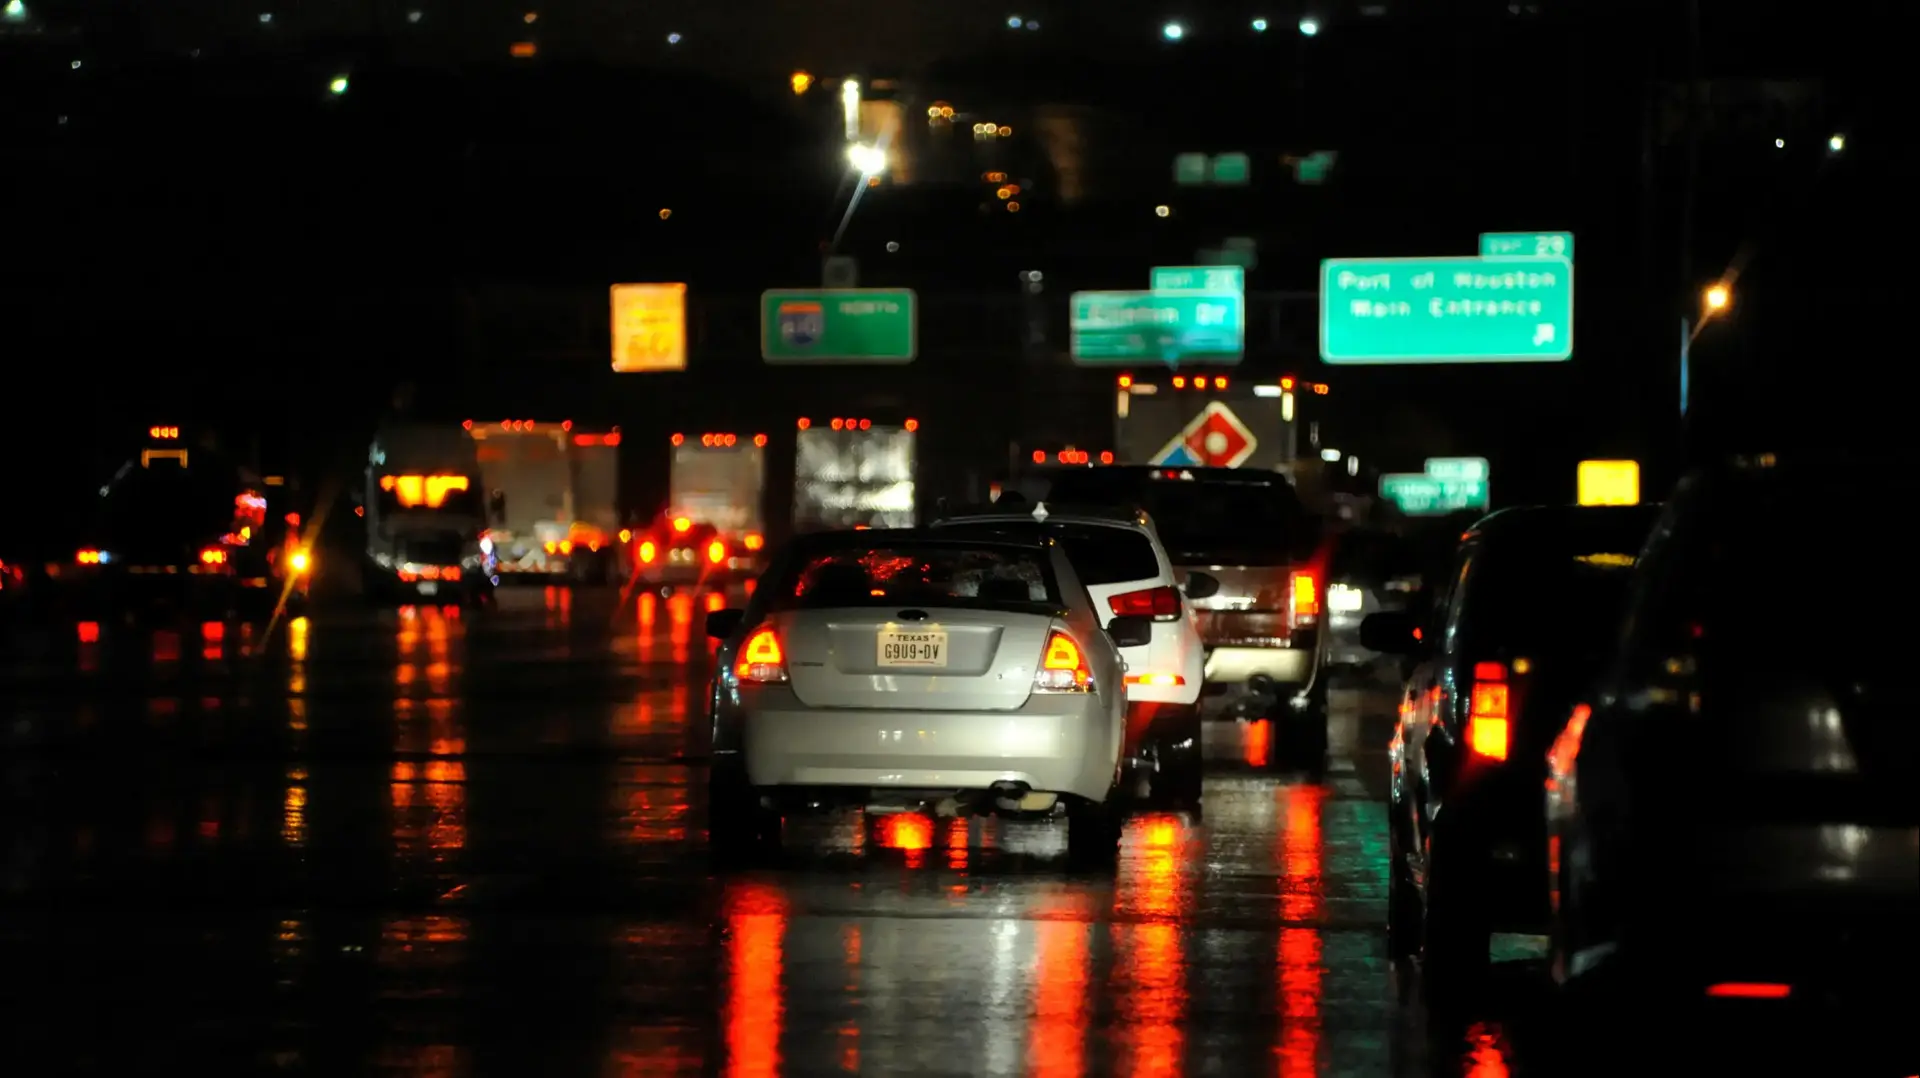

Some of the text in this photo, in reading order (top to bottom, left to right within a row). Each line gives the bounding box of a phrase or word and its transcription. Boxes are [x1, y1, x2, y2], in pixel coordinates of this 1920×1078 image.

[1337, 271, 1556, 290] Port of Houston
[1350, 297, 1542, 318] Main Entrance
